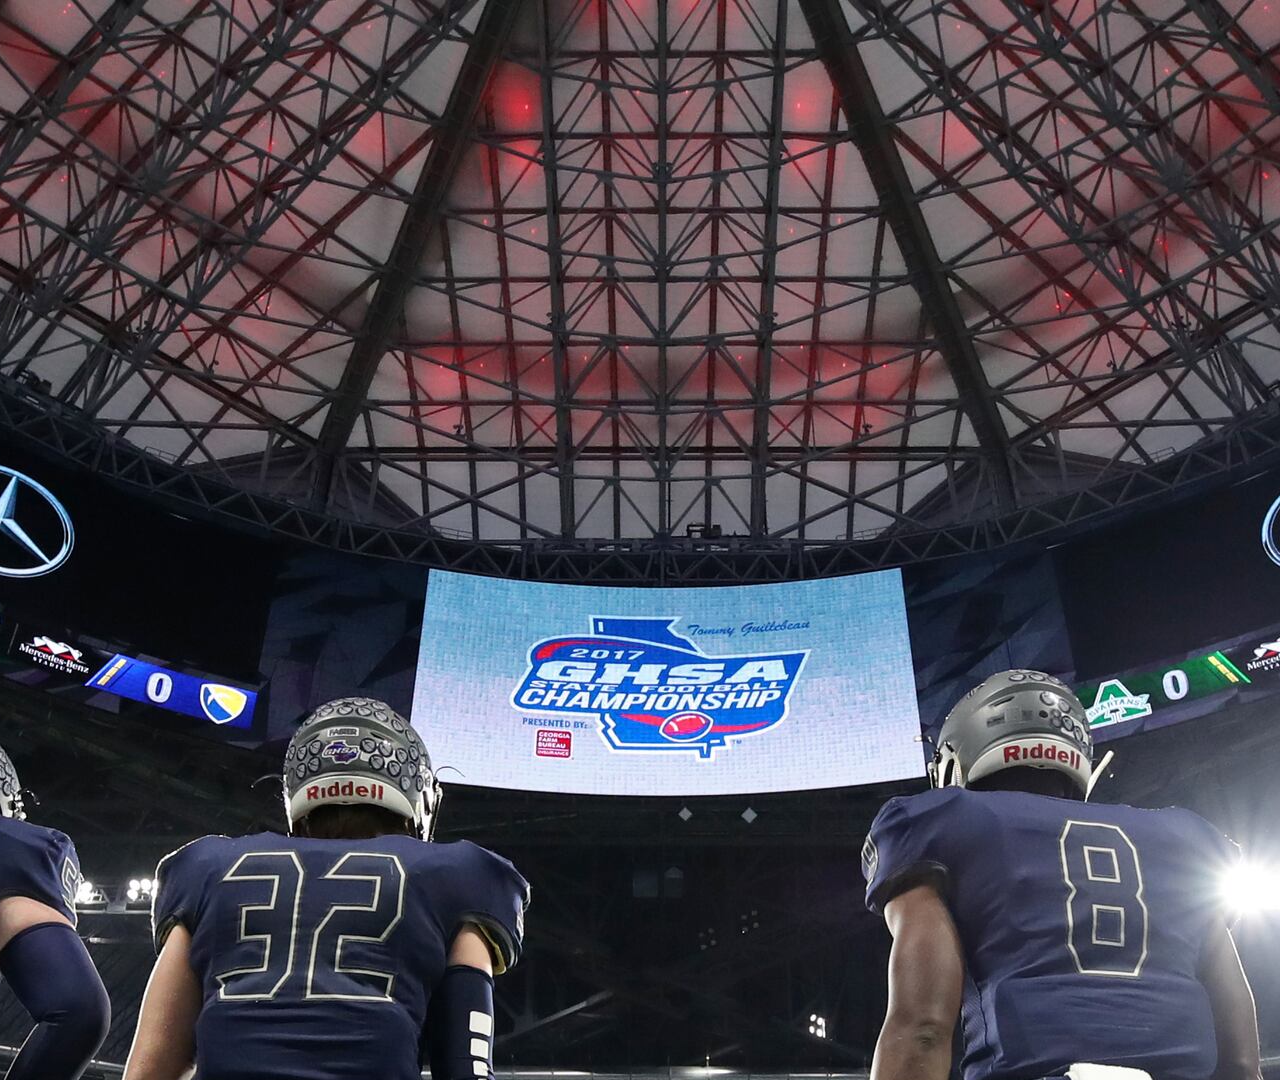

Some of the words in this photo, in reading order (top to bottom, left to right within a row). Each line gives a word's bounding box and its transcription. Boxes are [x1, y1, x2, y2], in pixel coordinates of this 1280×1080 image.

[687, 624, 734, 638] Tommy
[19, 642, 89, 674] Mercedes-Benz
[569, 648, 646, 660] 2017
[32, 656, 73, 674] STADIUM
[535, 660, 790, 685] GHSA
[146, 672, 173, 703] 0
[528, 680, 619, 692] STATE
[641, 681, 785, 693] FOOTBALL
[1162, 669, 1189, 700] 0
[519, 688, 782, 711] CHAMPIONSHIP
[522, 717, 571, 729] PRESENTED
[573, 720, 588, 729] BY:
[537, 731, 571, 739] GEORGIA
[323, 747, 360, 757] GHSA
[1003, 743, 1081, 770] Riddell
[306, 781, 384, 800] Riddell
[1059, 819, 1149, 978] 8
[216, 851, 407, 1002] 32
